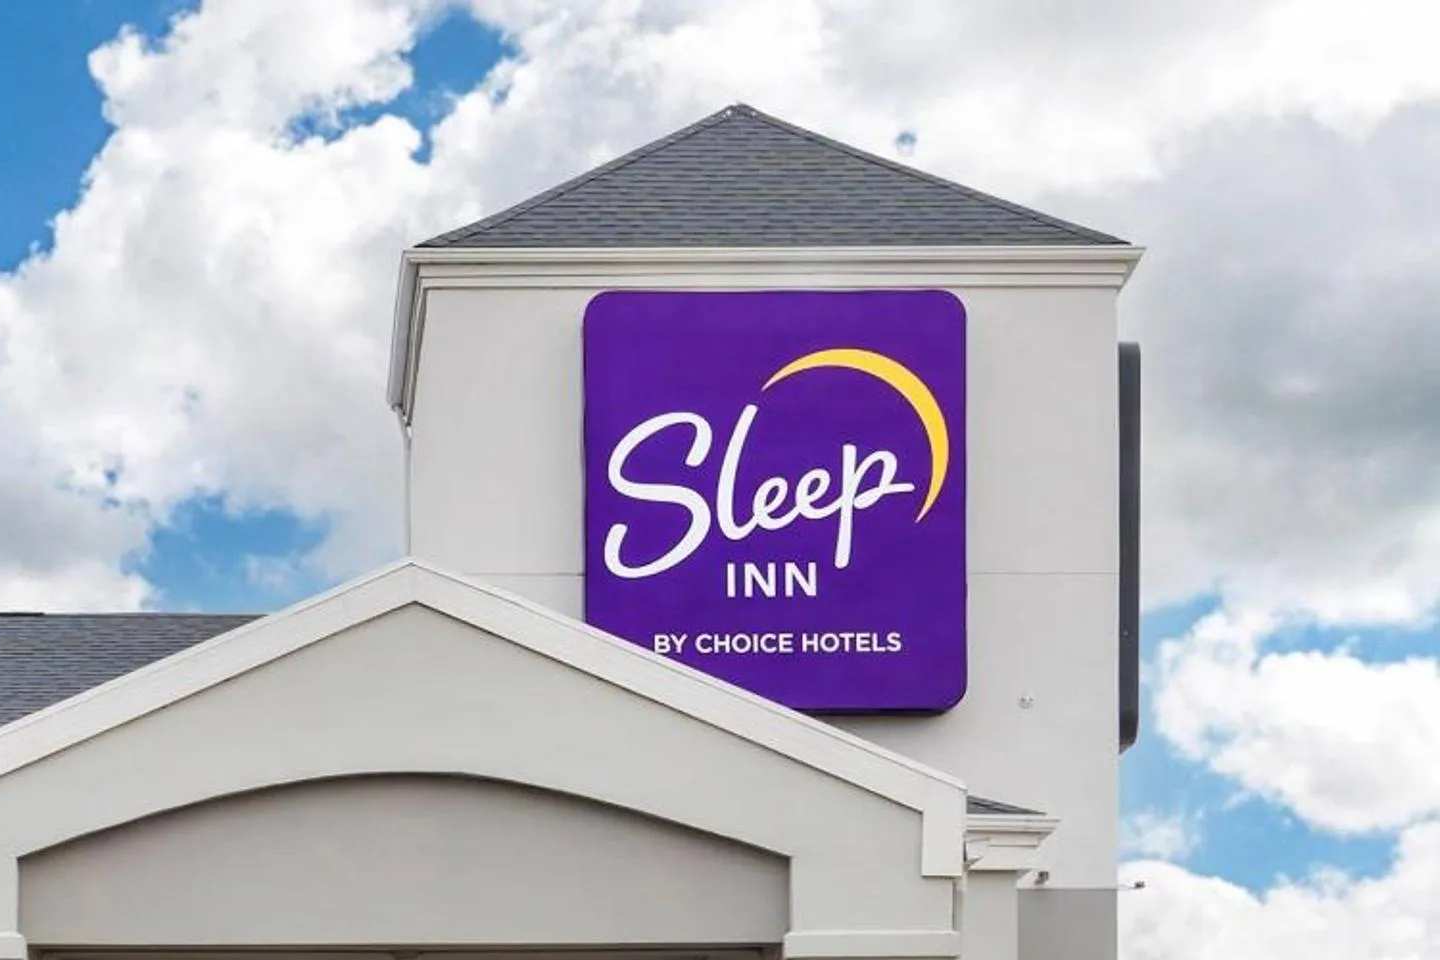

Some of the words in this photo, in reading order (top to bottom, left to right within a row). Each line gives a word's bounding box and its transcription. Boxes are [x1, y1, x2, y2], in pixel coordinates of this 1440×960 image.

[604, 404, 915, 579] Sleep
[726, 562, 817, 598] INN
[653, 633, 688, 654] BY
[695, 633, 794, 654] CHOICE
[801, 632, 903, 653] HOTELS
